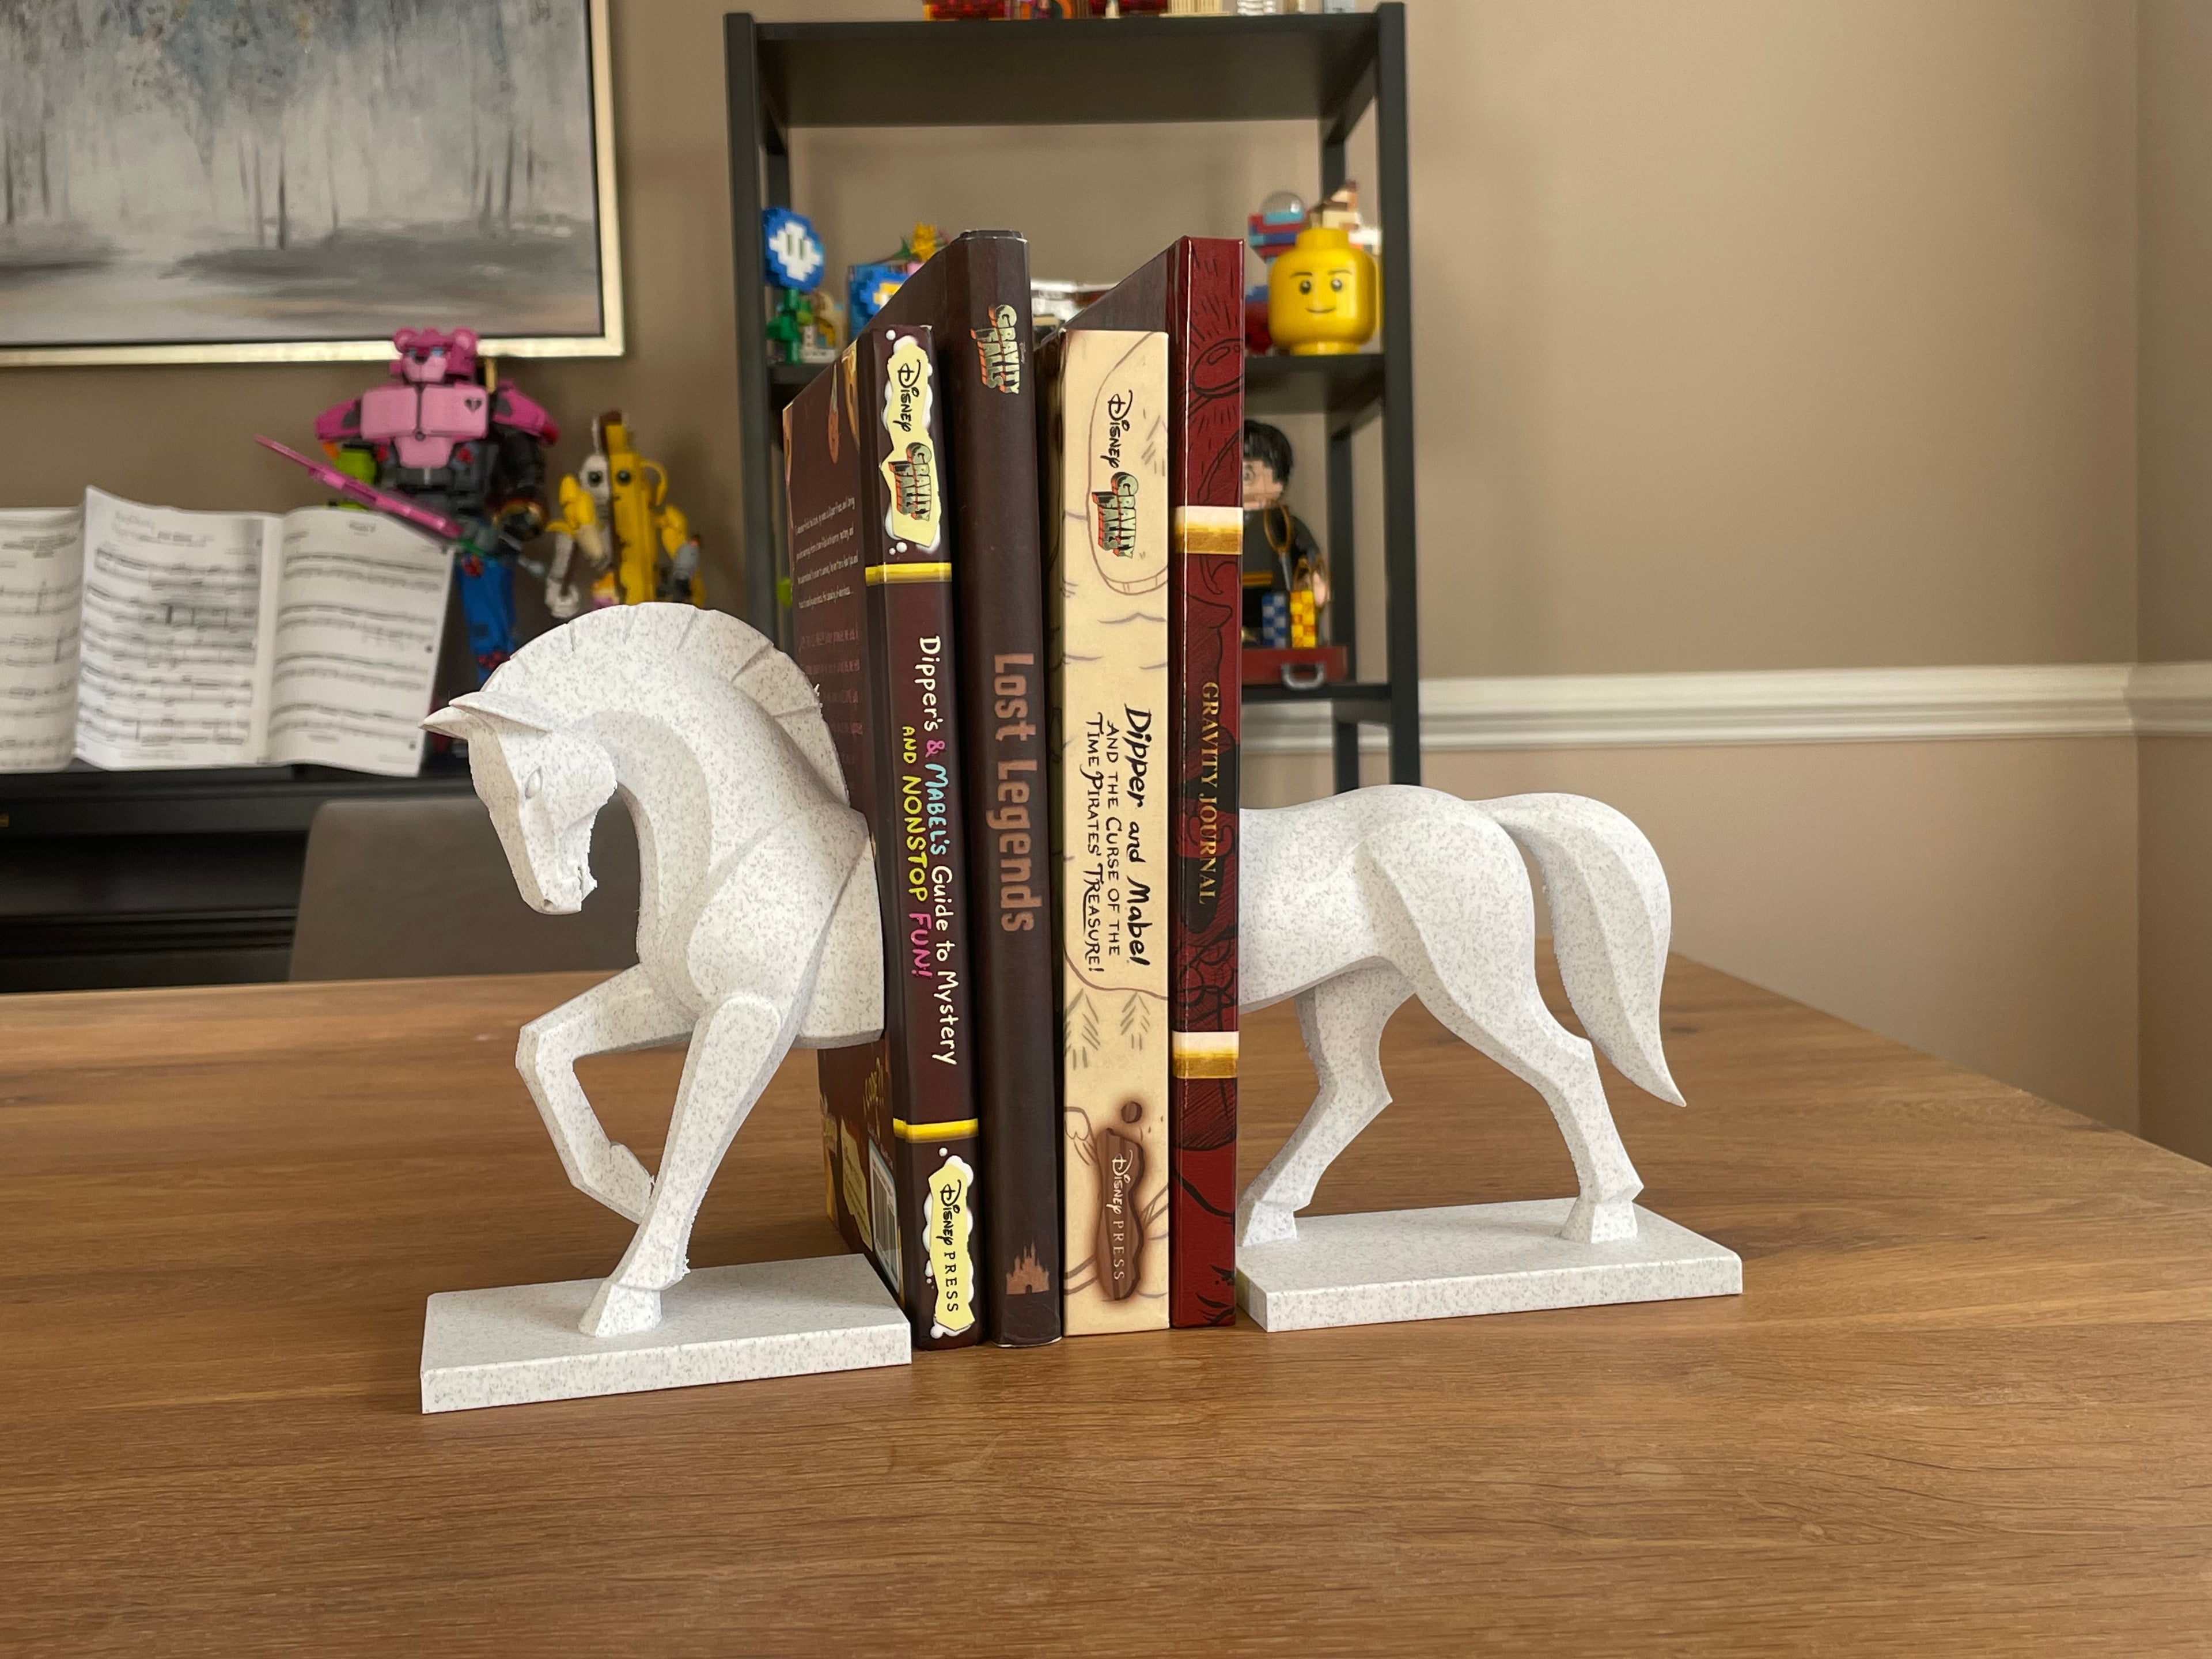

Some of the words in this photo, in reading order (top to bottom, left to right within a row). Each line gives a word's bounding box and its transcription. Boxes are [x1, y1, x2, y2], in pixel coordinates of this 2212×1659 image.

[970, 327, 1004, 388] FALLS
[988, 304, 1020, 395] GRAVITY
[893, 359, 922, 433] Disney
[1100, 389, 1134, 468] Disney
[888, 461, 915, 516] FALLS
[906, 441, 931, 521] GRAVITY
[1092, 492, 1119, 551] FALLS
[1111, 472, 1139, 559] GRAVITY
[915, 635, 944, 732] Dipper's
[994, 652, 1036, 742] Lost
[902, 726, 917, 764] AND
[925, 740, 945, 758] &
[1086, 711, 1104, 767] TIME
[1106, 720, 1119, 763] AND
[1122, 703, 1152, 808] Dipper
[1200, 681, 1219, 788] GRAVITY
[1080, 764, 1104, 857] PIRATES'
[1107, 771, 1119, 809] THE
[902, 775, 928, 902] NONSTOP
[986, 760, 1043, 933] Legends
[1105, 817, 1122, 881] CURSE
[1127, 821, 1146, 863] and
[1198, 793, 1218, 905] JOURNAL
[931, 865, 954, 931] Guide
[1082, 862, 1105, 972] TREASURE!
[1107, 888, 1120, 914] OF
[1126, 874, 1153, 966] Mabel
[909, 912, 933, 978] FUN!
[936, 940, 955, 961] to
[1108, 919, 1120, 956] THE
[932, 971, 959, 1065] Mystery
[930, 1179, 961, 1246] Disney
[1104, 1147, 1134, 1214] Disney
[944, 1251, 959, 1313] PRESS
[1112, 1219, 1126, 1281] PRESS
